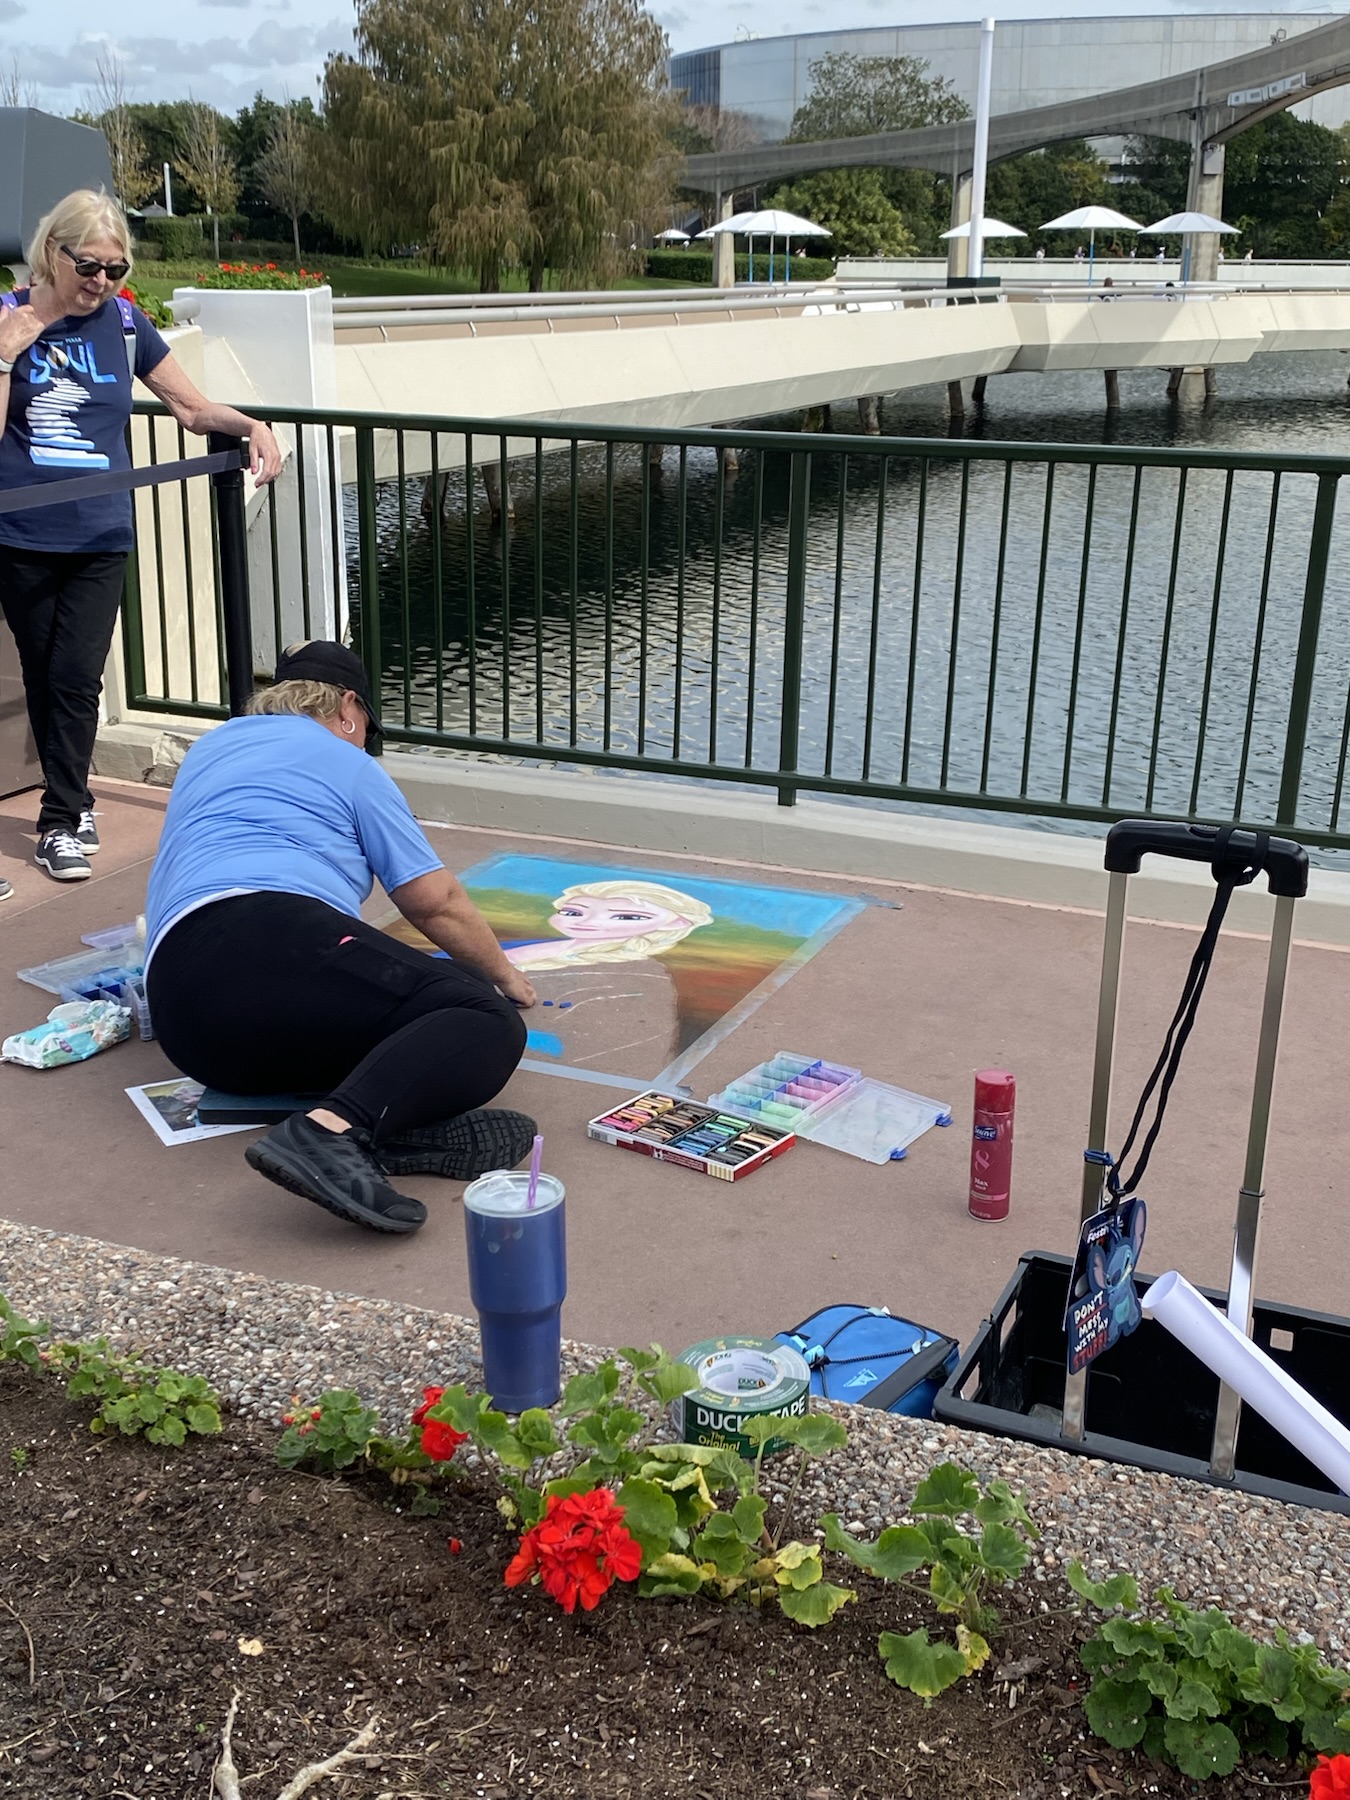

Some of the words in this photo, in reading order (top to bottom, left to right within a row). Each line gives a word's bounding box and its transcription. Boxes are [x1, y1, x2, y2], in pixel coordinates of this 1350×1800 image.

[29, 342, 117, 384] SOUL
[1074, 1290, 1103, 1324] DON'T
[1079, 1312, 1101, 1338] MESS
[1097, 1317, 1108, 1333] MY
[1073, 1329, 1107, 1370] STUFF!
[697, 1407, 751, 1433] DUCK
